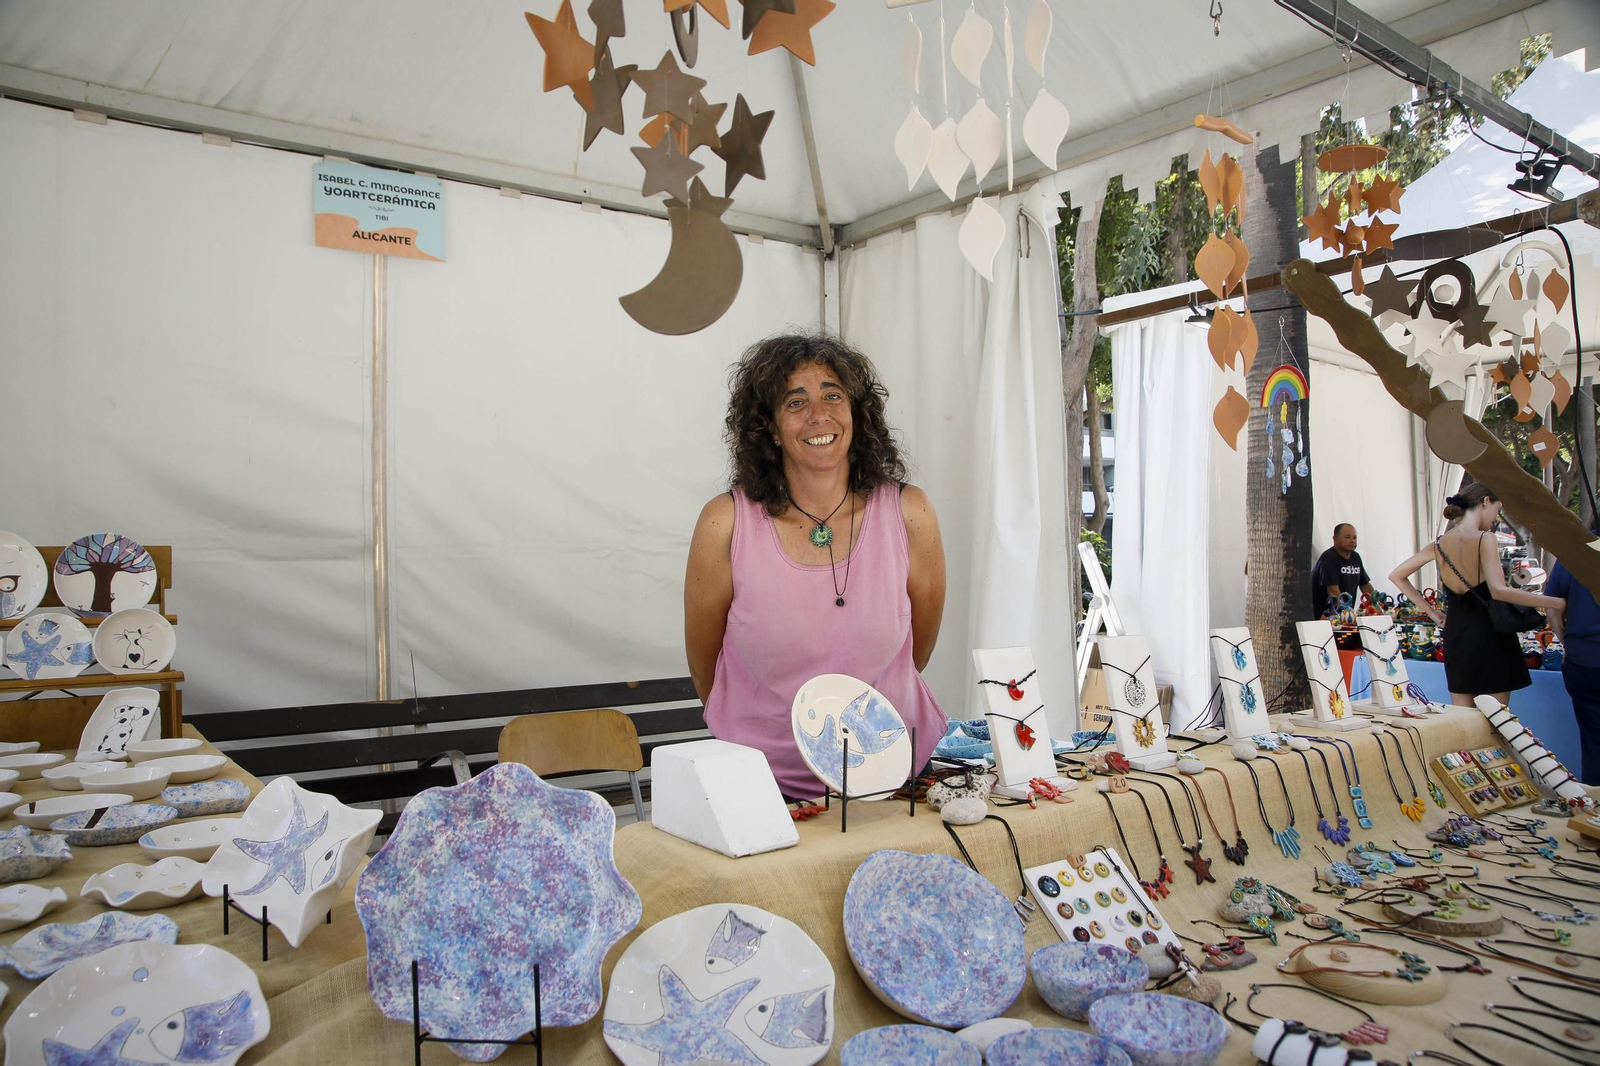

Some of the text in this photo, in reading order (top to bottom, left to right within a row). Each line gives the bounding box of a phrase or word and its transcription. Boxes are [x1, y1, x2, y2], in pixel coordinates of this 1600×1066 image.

[318, 173, 356, 187] ISABEL
[358, 180, 368, 188] C.
[323, 186, 436, 210] YOARTCERÁMICA
[352, 230, 412, 245] ALICANTE
[1113, 777, 1126, 788] 20
[1075, 855, 1084, 864] 10
